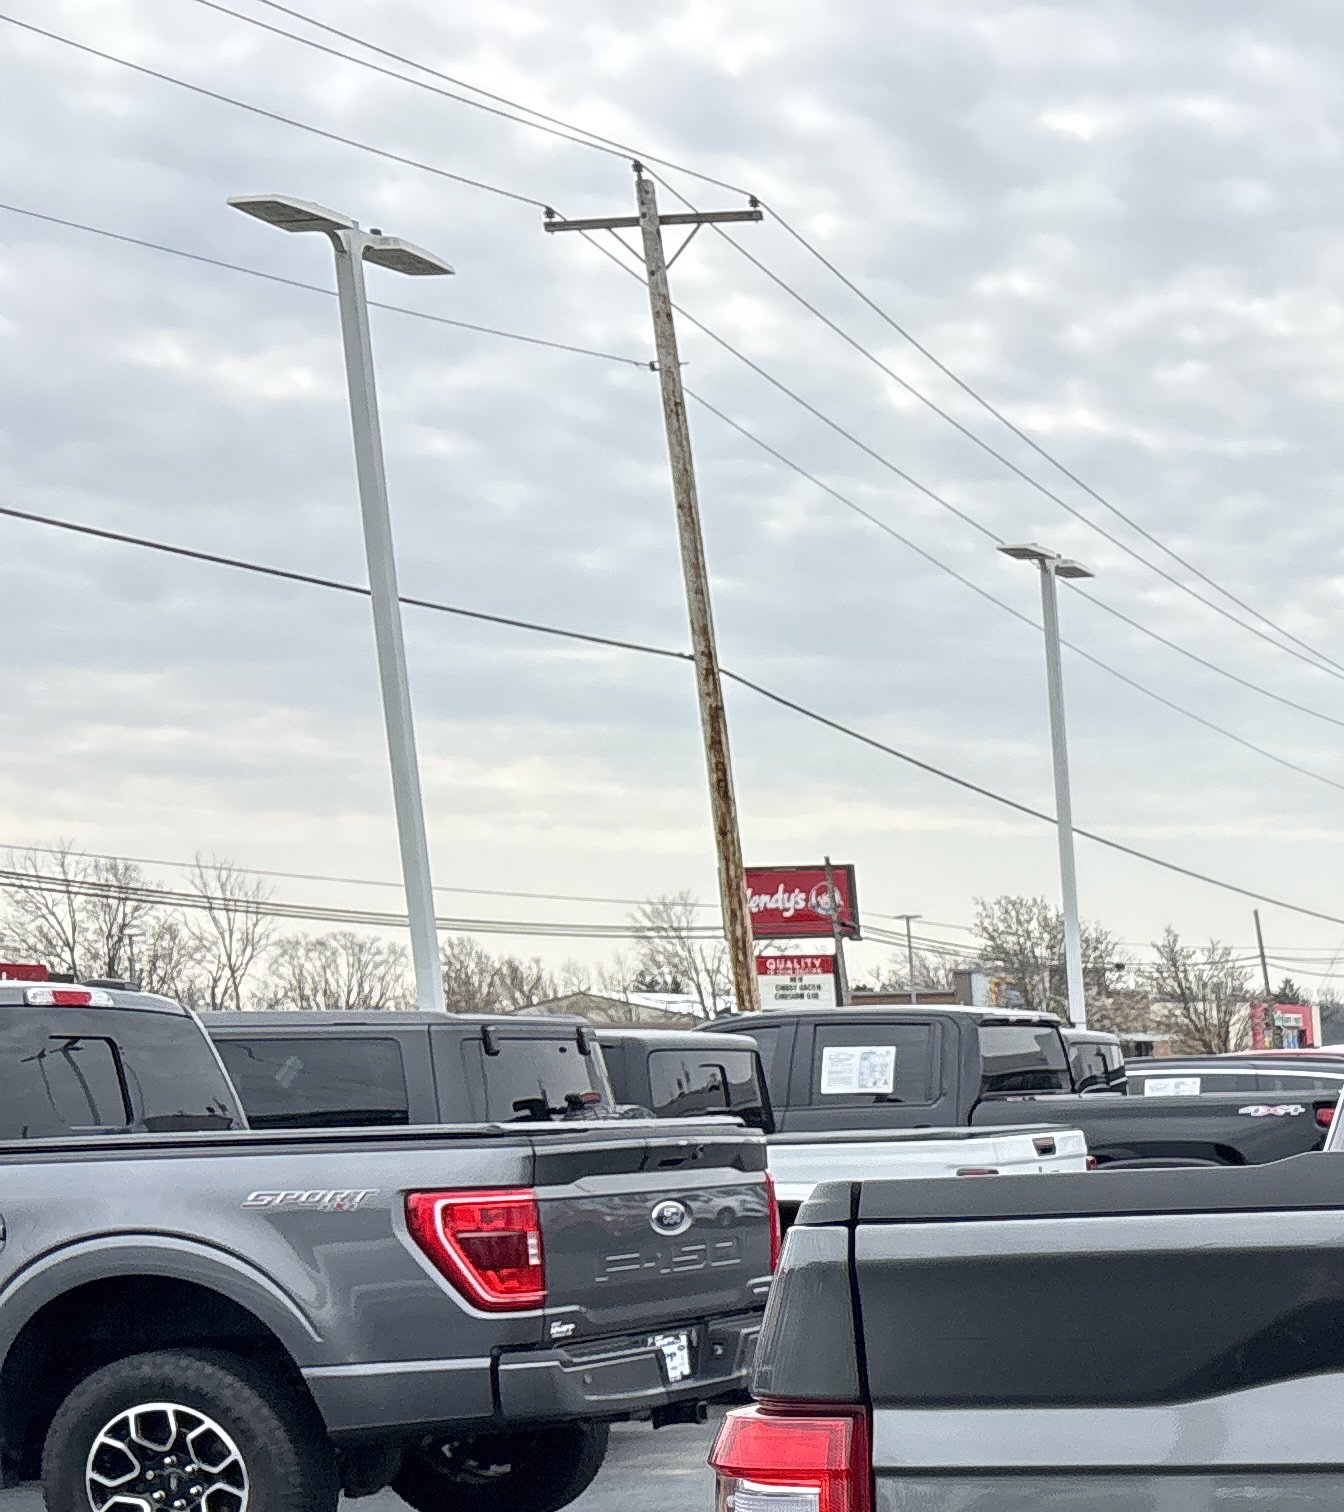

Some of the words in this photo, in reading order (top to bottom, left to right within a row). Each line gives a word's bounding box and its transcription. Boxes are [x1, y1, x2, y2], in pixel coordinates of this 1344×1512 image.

[747, 883, 806, 917] endy's
[766, 958, 822, 970] QUALITY
[242, 1189, 380, 1210] SPORT
